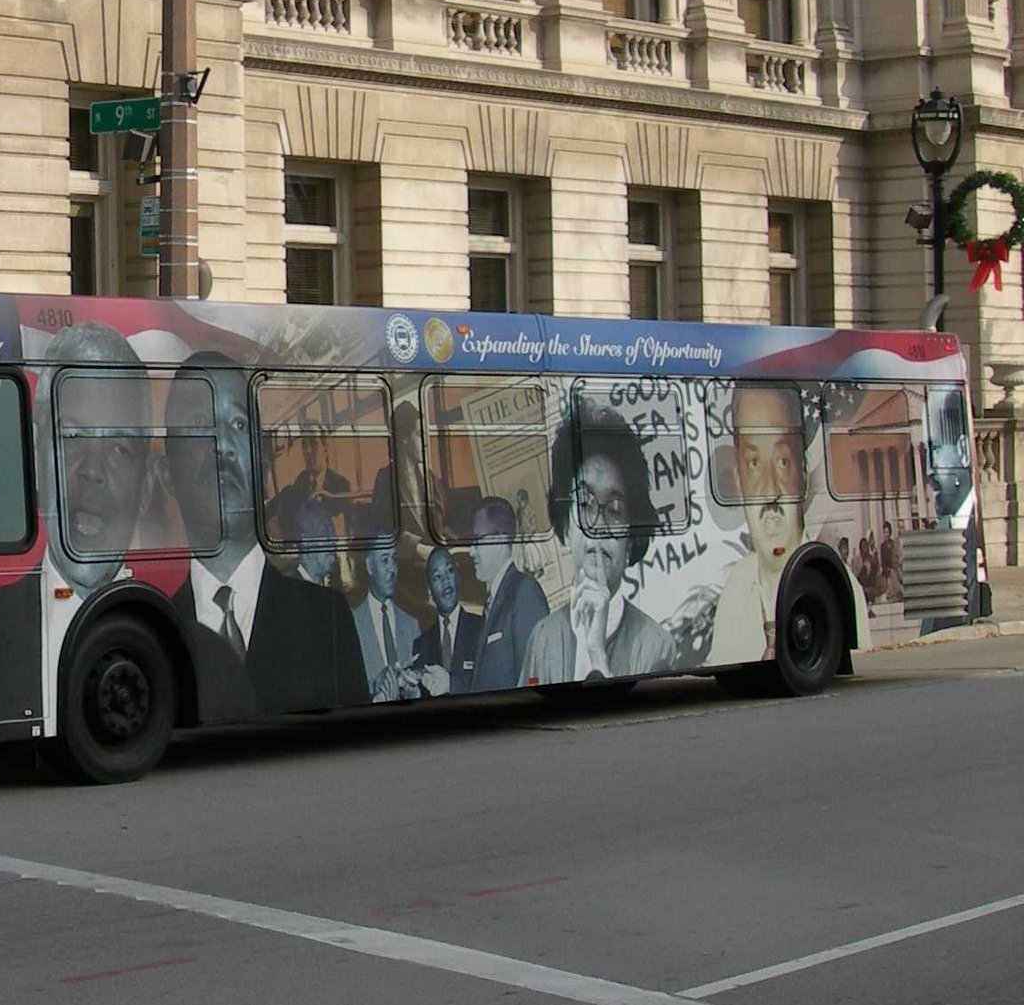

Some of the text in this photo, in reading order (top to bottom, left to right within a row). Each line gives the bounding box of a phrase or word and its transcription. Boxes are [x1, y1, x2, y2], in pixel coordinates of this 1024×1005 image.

[37, 308, 73, 327] 4810
[462, 329, 545, 363] Expanding
[548, 333, 569, 355] the
[573, 334, 622, 357] Shores
[625, 336, 644, 366] of
[644, 336, 722, 369] Opportunity
[610, 374, 670, 406] GOOD
[478, 399, 512, 426] THE
[623, 532, 707, 599] SMALL
